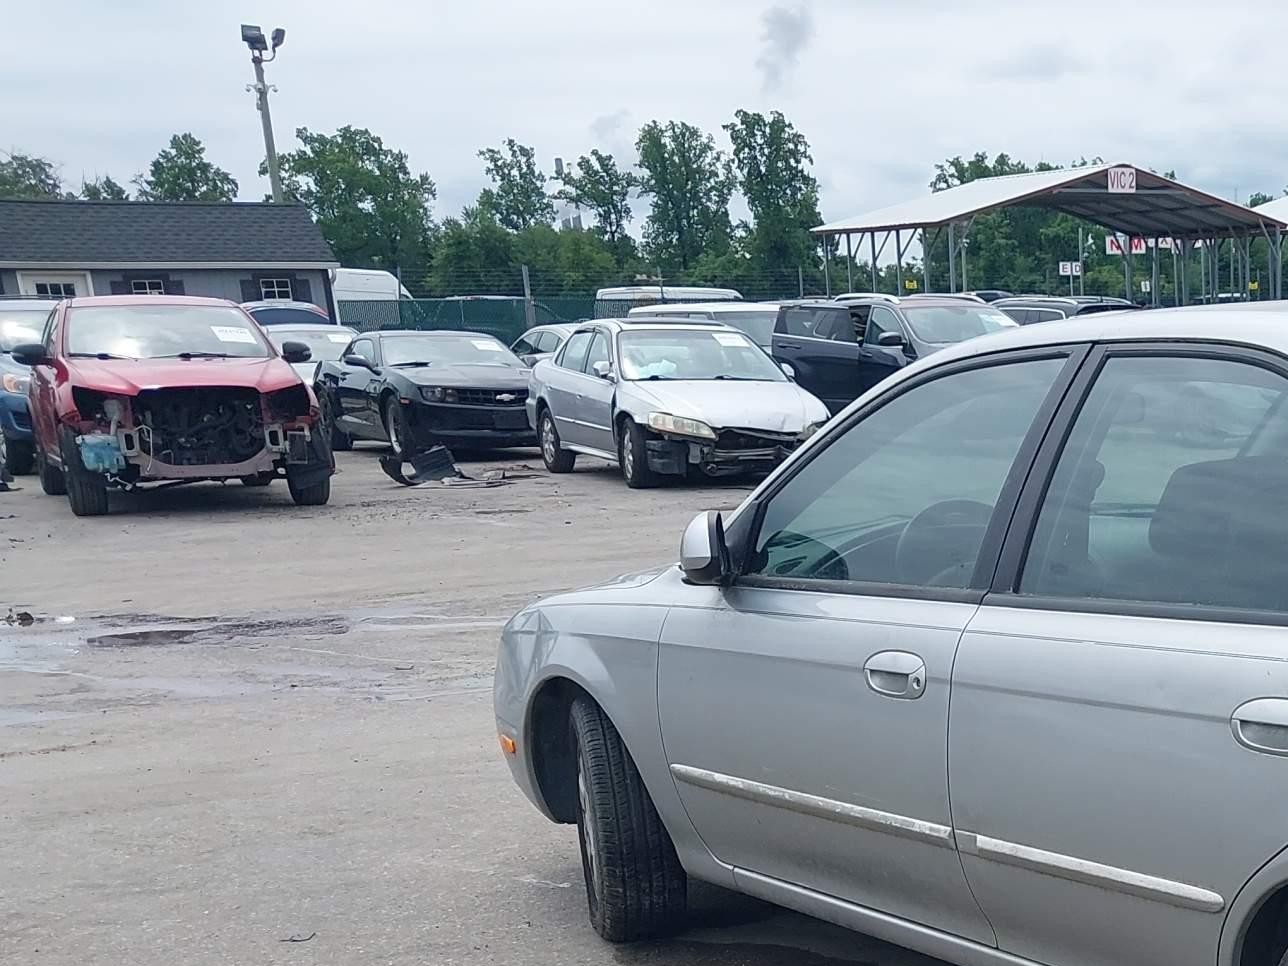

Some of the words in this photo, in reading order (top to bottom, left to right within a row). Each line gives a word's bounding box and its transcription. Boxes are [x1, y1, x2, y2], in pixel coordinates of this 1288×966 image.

[1109, 171, 1126, 189] VIC
[1128, 172, 1135, 189] 2
[1132, 239, 1142, 251] M
[1062, 263, 1069, 273] E
